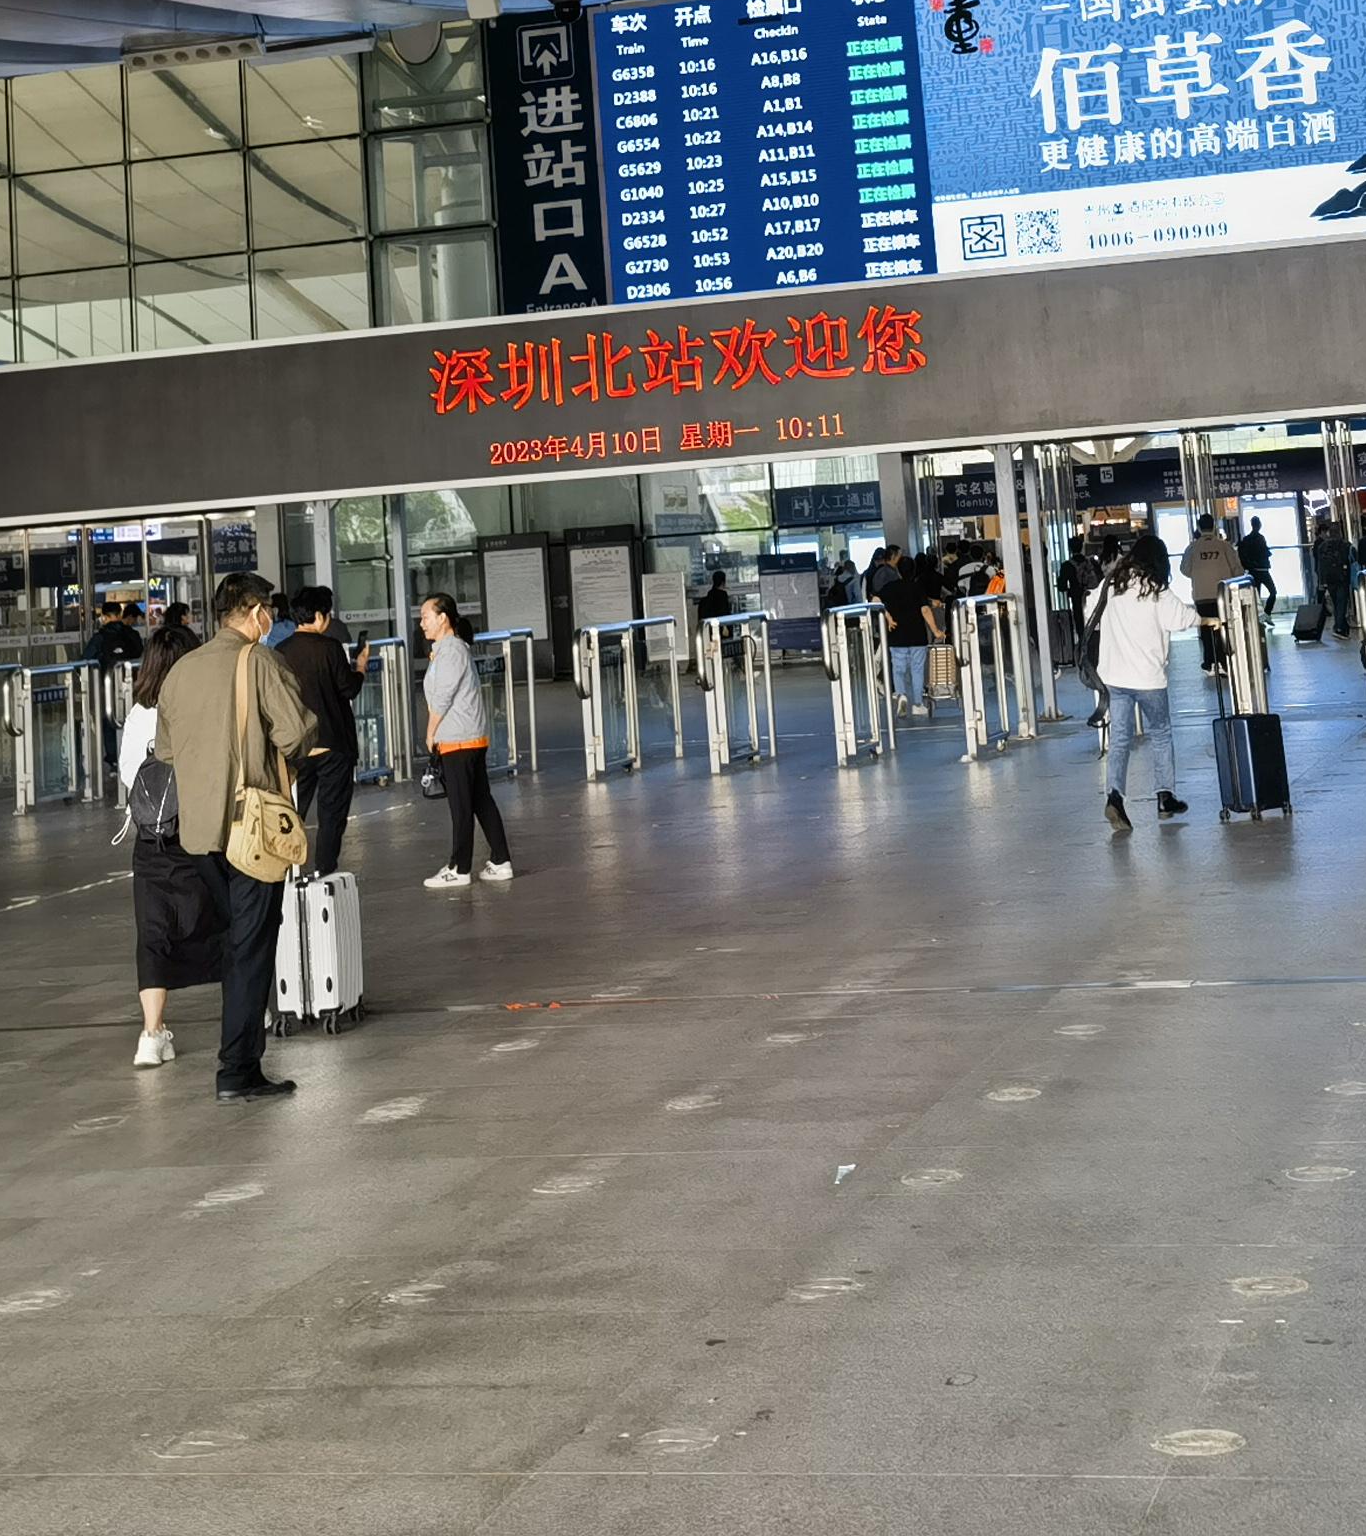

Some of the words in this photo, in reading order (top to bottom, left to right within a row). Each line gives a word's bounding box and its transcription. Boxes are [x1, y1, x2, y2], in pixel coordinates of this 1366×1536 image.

[611, 13, 647, 34] 车次
[675, 5, 711, 27] 开点
[616, 43, 645, 55] Train
[681, 36, 709, 48] Time
[857, 14, 887, 27] State
[679, 58, 715, 74] 10:16
[750, 47, 807, 66] A16,B16
[846, 36, 903, 57] 正在检票
[681, 82, 717, 98] 10:16
[761, 73, 801, 89] A8,B8
[848, 60, 906, 81] 正在检票
[1030, 19, 1332, 133] 佰草香
[682, 106, 719, 122] 10:21
[763, 96, 803, 113] A1,B1
[850, 85, 908, 105] 正在检票
[617, 137, 660, 153] G6554
[684, 130, 721, 146] 10:22
[756, 120, 813, 138] A14,B14
[852, 109, 910, 130] 正在检票
[1039, 109, 1337, 174] 更健康的高端白酒
[618, 161, 662, 178] G5629
[686, 154, 723, 171] 10:23
[758, 144, 815, 163] A11,B11
[854, 134, 912, 154] 正在检票
[620, 185, 664, 201] G1040
[688, 178, 724, 194] 10:25
[760, 169, 817, 187] A15,B15
[856, 158, 914, 179] 正在检票
[621, 209, 665, 226] D2334
[689, 203, 726, 219] 10:27
[762, 194, 819, 212] A10,B10
[858, 183, 916, 204] 正在检票
[623, 234, 667, 250] G6528
[691, 227, 728, 243] 10:52
[764, 218, 821, 236] A17,B17
[625, 258, 669, 275] G2730
[693, 252, 730, 268] 10:53
[766, 243, 824, 261] A20,B20
[627, 283, 671, 299] D2306
[695, 276, 733, 293] 10:56
[776, 268, 817, 285] A6,B6
[429, 304, 928, 414] 深圳北站欢迎您
[490, 427, 662, 465] 2023年4月10日
[680, 421, 760, 450] 星期一
[776, 413, 844, 441] 10:11
[1102, 469, 1113, 480] 15
[818, 492, 875, 509] 人工通道
[956, 497, 994, 508] Identity
